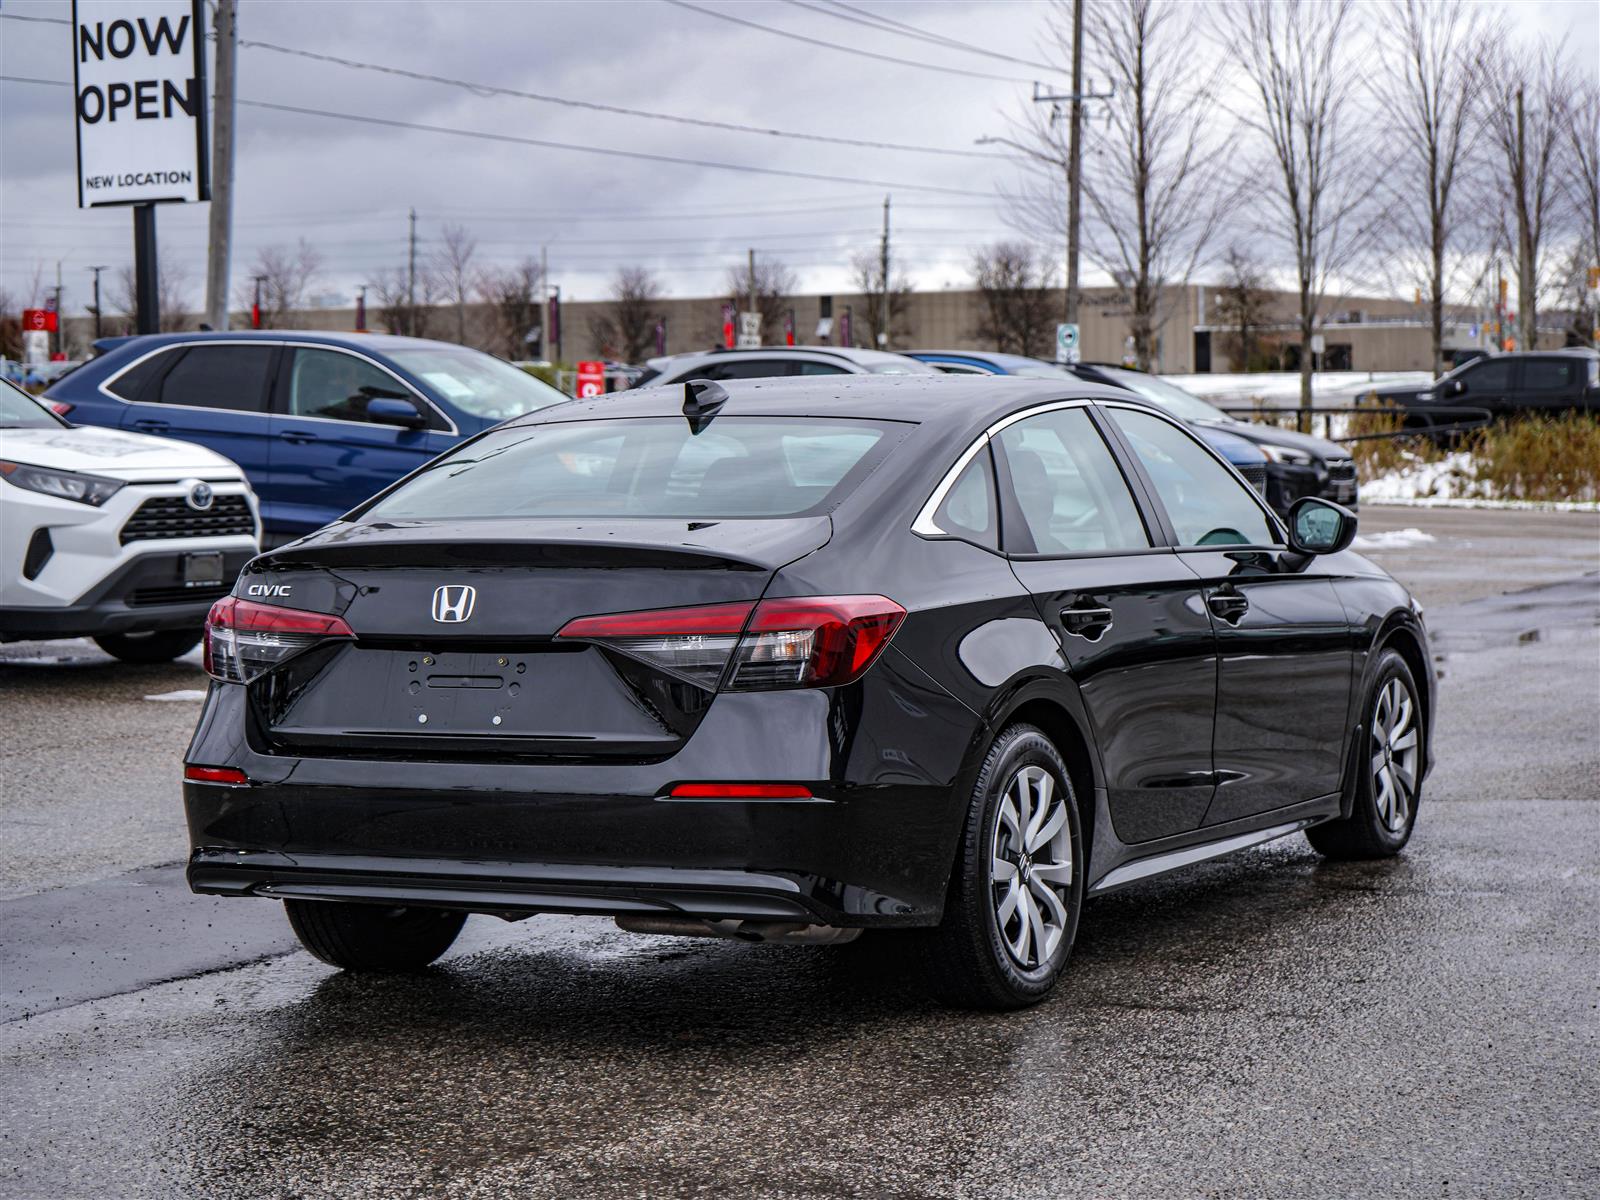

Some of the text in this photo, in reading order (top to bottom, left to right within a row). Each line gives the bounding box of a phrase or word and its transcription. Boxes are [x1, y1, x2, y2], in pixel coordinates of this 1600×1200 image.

[80, 15, 190, 62] NOW
[77, 78, 197, 124] OPEN
[86, 171, 191, 189] NEW LOCATION
[248, 584, 292, 597] CIVIC
